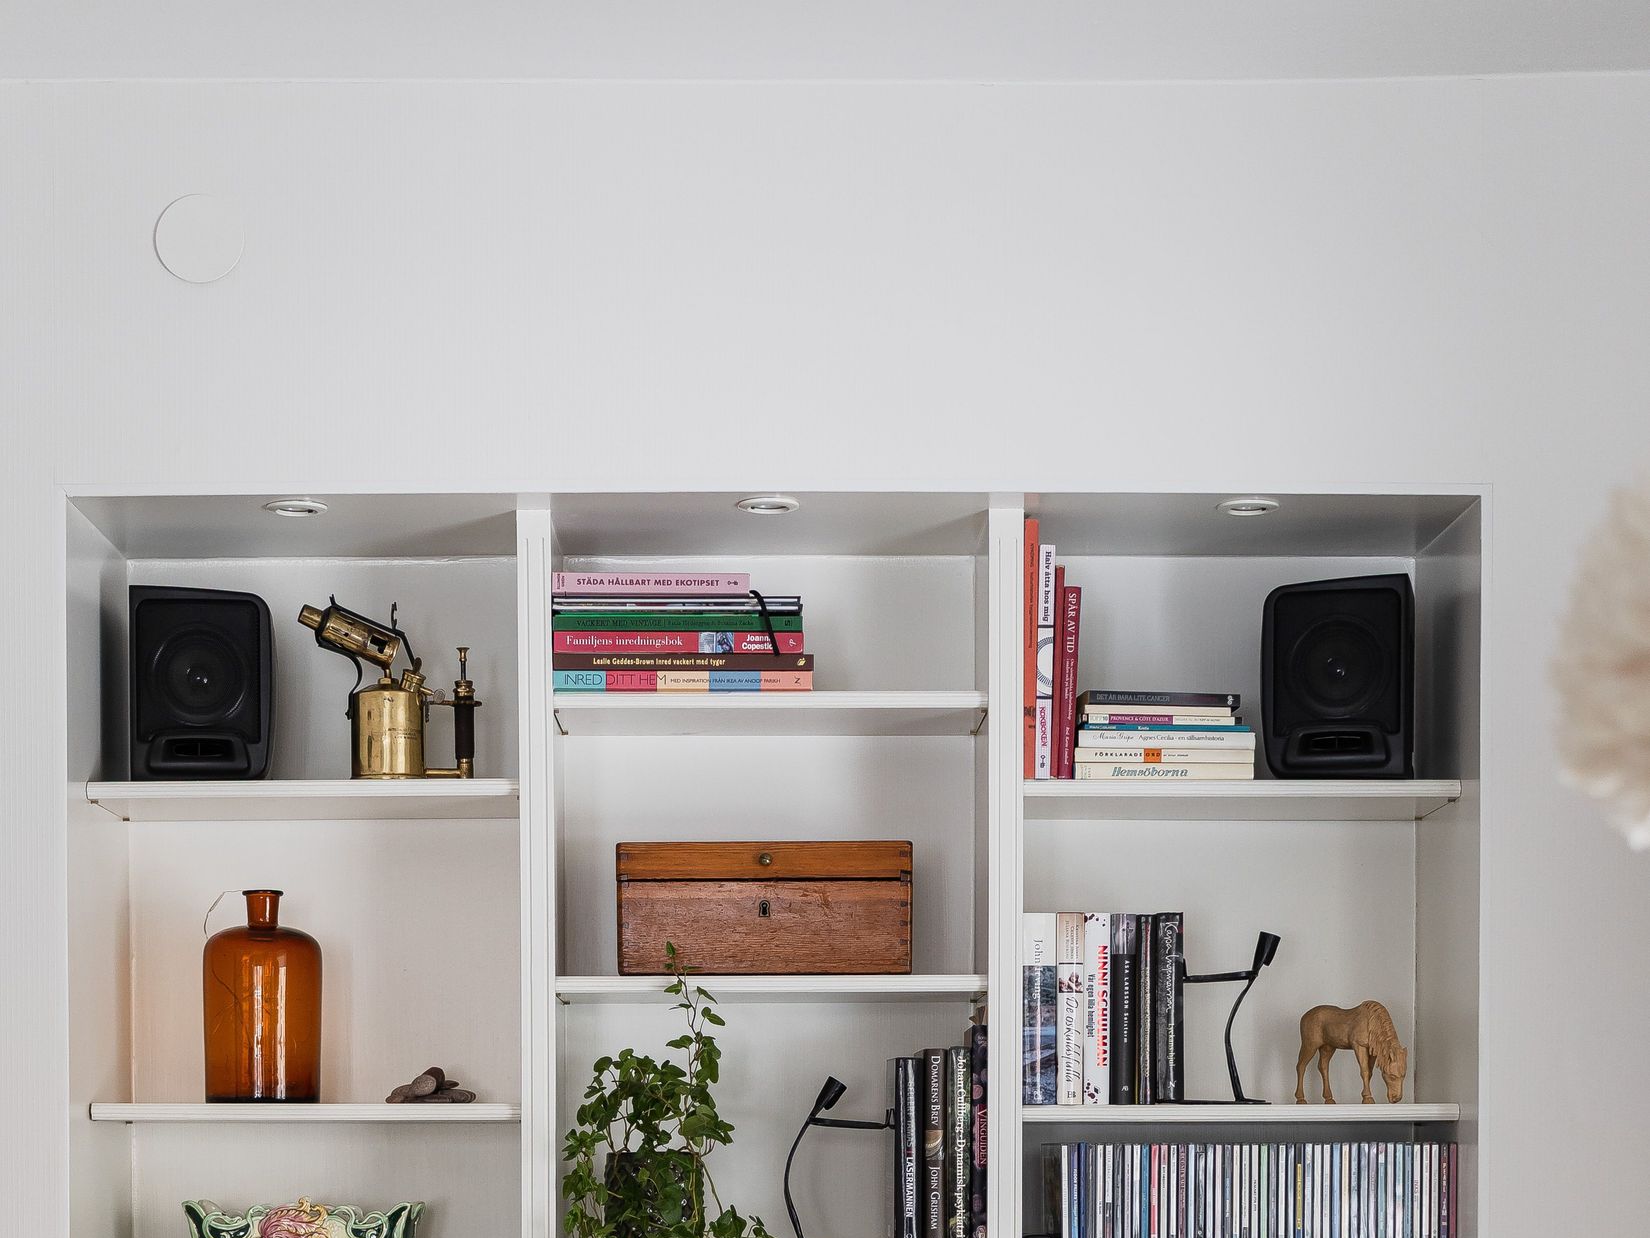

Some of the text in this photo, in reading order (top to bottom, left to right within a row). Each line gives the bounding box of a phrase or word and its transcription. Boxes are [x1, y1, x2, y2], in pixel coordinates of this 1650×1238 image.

[577, 576, 605, 586] STÄDA
[608, 577, 651, 586] HÅLLBART
[675, 579, 720, 587] EKOTIPSET
[1042, 606, 1050, 622] mig
[630, 619, 662, 627] VINTAGE
[1066, 592, 1078, 653] SPÅR AV TID
[566, 635, 683, 649] Familjens inredningsbok
[746, 634, 771, 642] Joann
[741, 643, 773, 652] Copestic
[593, 657, 611, 665] Leslie
[612, 657, 655, 666] Geddes-Brown
[673, 658, 695, 666] vackert
[696, 658, 709, 666] med
[710, 659, 725, 667] tyger
[564, 673, 667, 686] INRED DITT HEM
[1111, 766, 1189, 777] Hemsöborna
[1033, 940, 1043, 963] John
[1086, 984, 1094, 998] egen
[1087, 999, 1095, 1009] lilla
[1097, 945, 1108, 1067] NINNI SCHULMAN
[1086, 1011, 1095, 1038] hemlighet
[930, 1055, 940, 1126] DOMARENS BREV
[977, 1108, 987, 1165] VINGUIDEN
[954, 1055, 966, 1238] Johan Cullberg Dynamisk psykiatri
[906, 1156, 914, 1218] LASERMANNEN
[928, 1165, 940, 1230] JOHN GRISHAM
